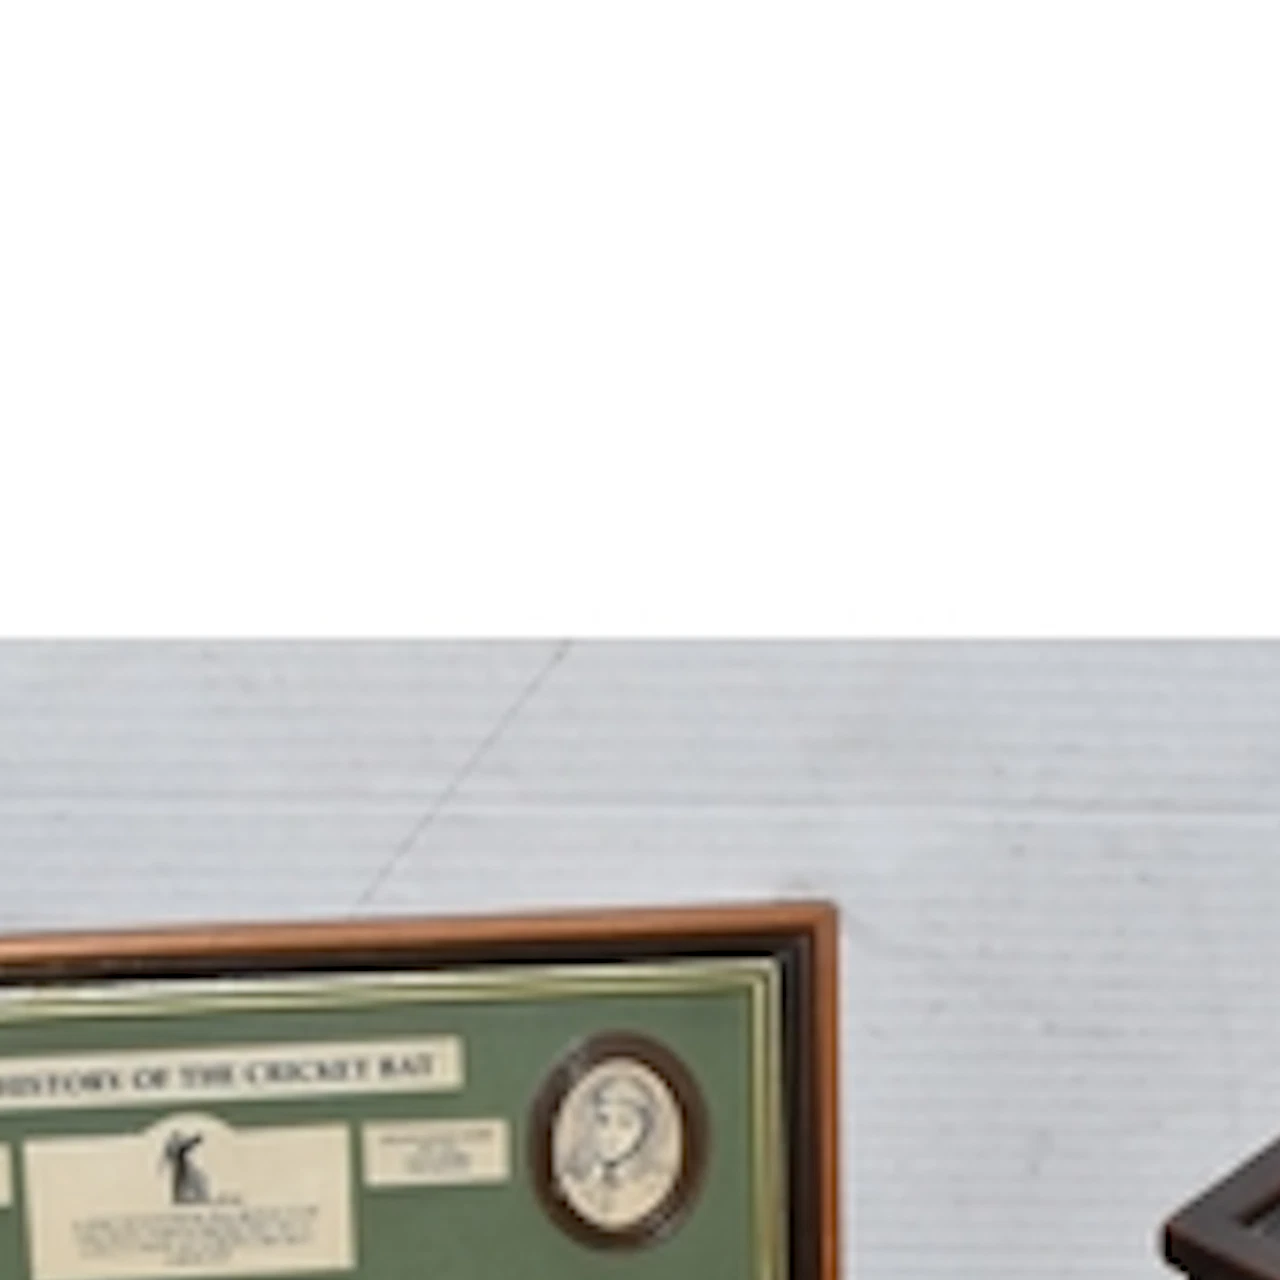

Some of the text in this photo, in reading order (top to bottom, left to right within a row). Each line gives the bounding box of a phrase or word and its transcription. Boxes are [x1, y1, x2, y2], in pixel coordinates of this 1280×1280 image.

[131, 1064, 170, 1092] OF
[177, 1062, 233, 1090] THE
[243, 1056, 367, 1085] CRICKET
[378, 1050, 434, 1079] BAT
